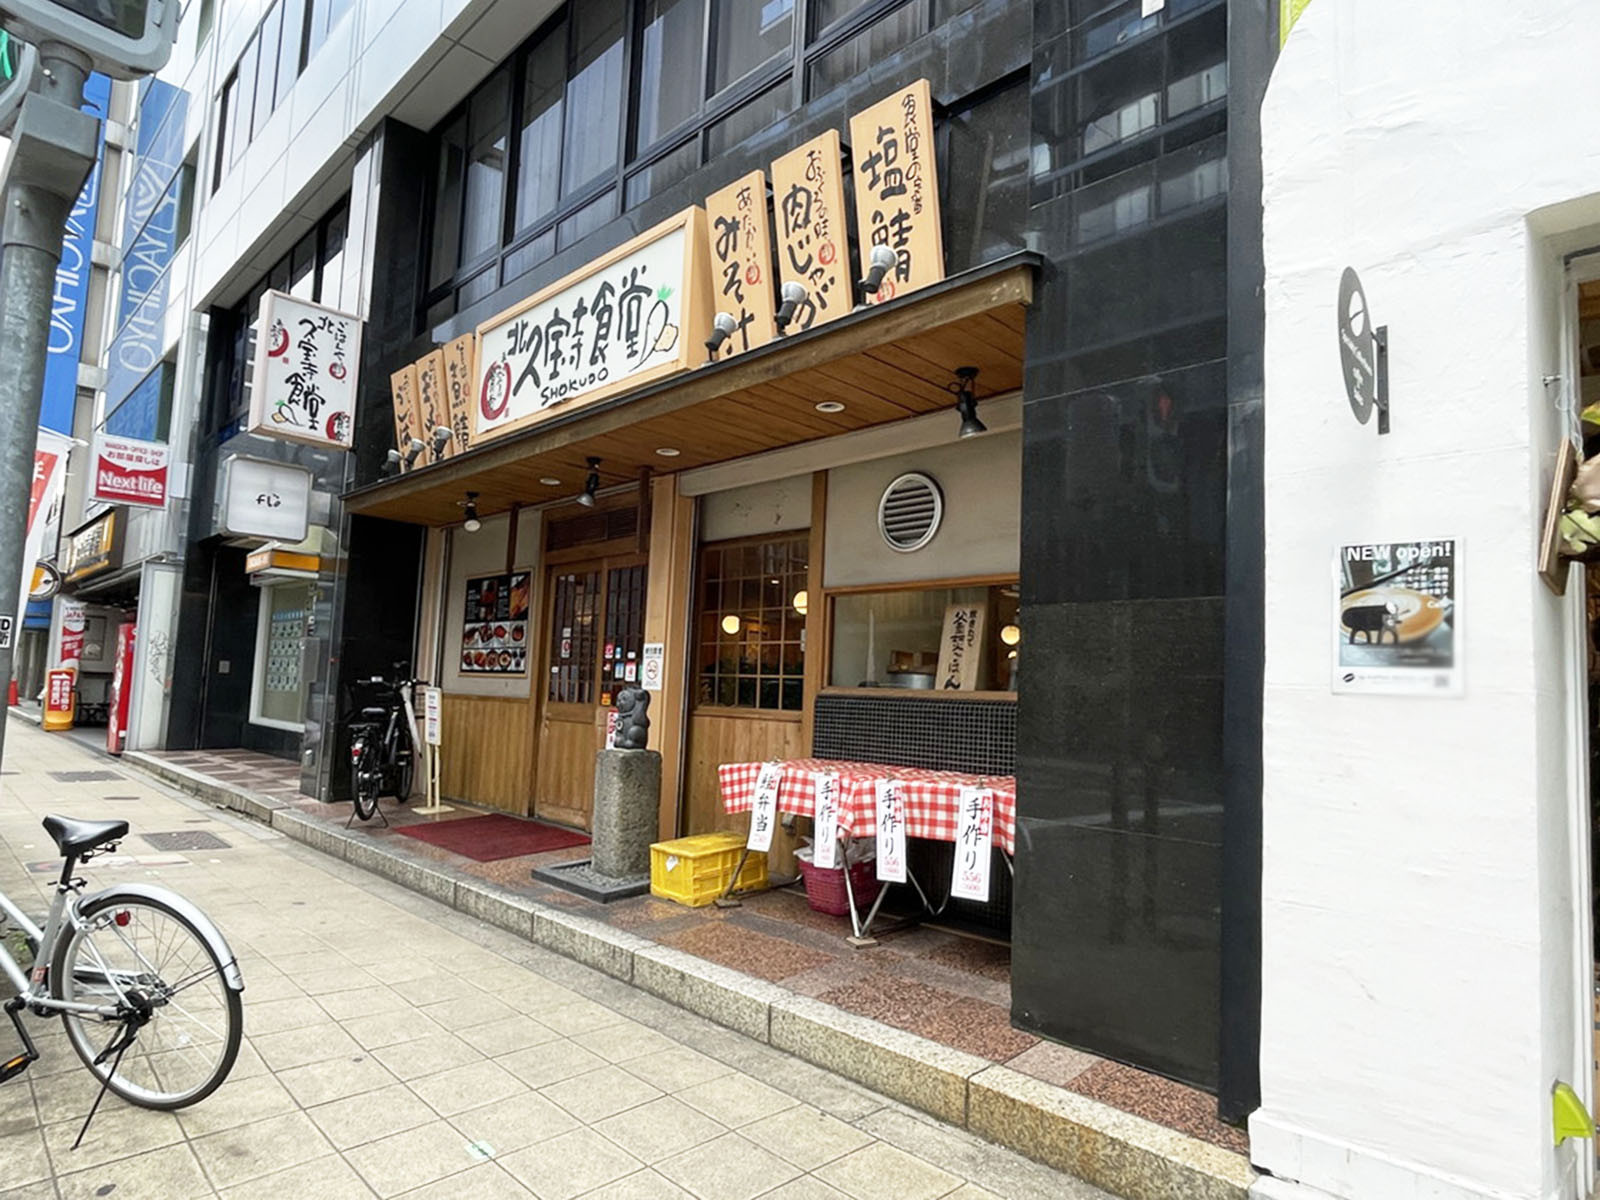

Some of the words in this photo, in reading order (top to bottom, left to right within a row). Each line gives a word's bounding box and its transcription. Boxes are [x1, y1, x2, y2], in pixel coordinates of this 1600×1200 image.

[736, 185, 757, 262] あったかい
[806, 149, 832, 242] おふくろの味
[860, 125, 915, 284] 塩鯖
[714, 215, 755, 356] みそ汁
[782, 183, 835, 331] 肉じゃが
[507, 265, 653, 397] 北久宝寺食堂
[540, 368, 610, 407] SHOKUDO
[99, 470, 136, 490] Next
[138, 475, 163, 493] life
[1347, 545, 1391, 561] NEW
[1396, 541, 1451, 562] open!
[820, 780, 834, 844] 手作り
[881, 788, 897, 855] 手作り
[963, 797, 983, 871] 手作り
